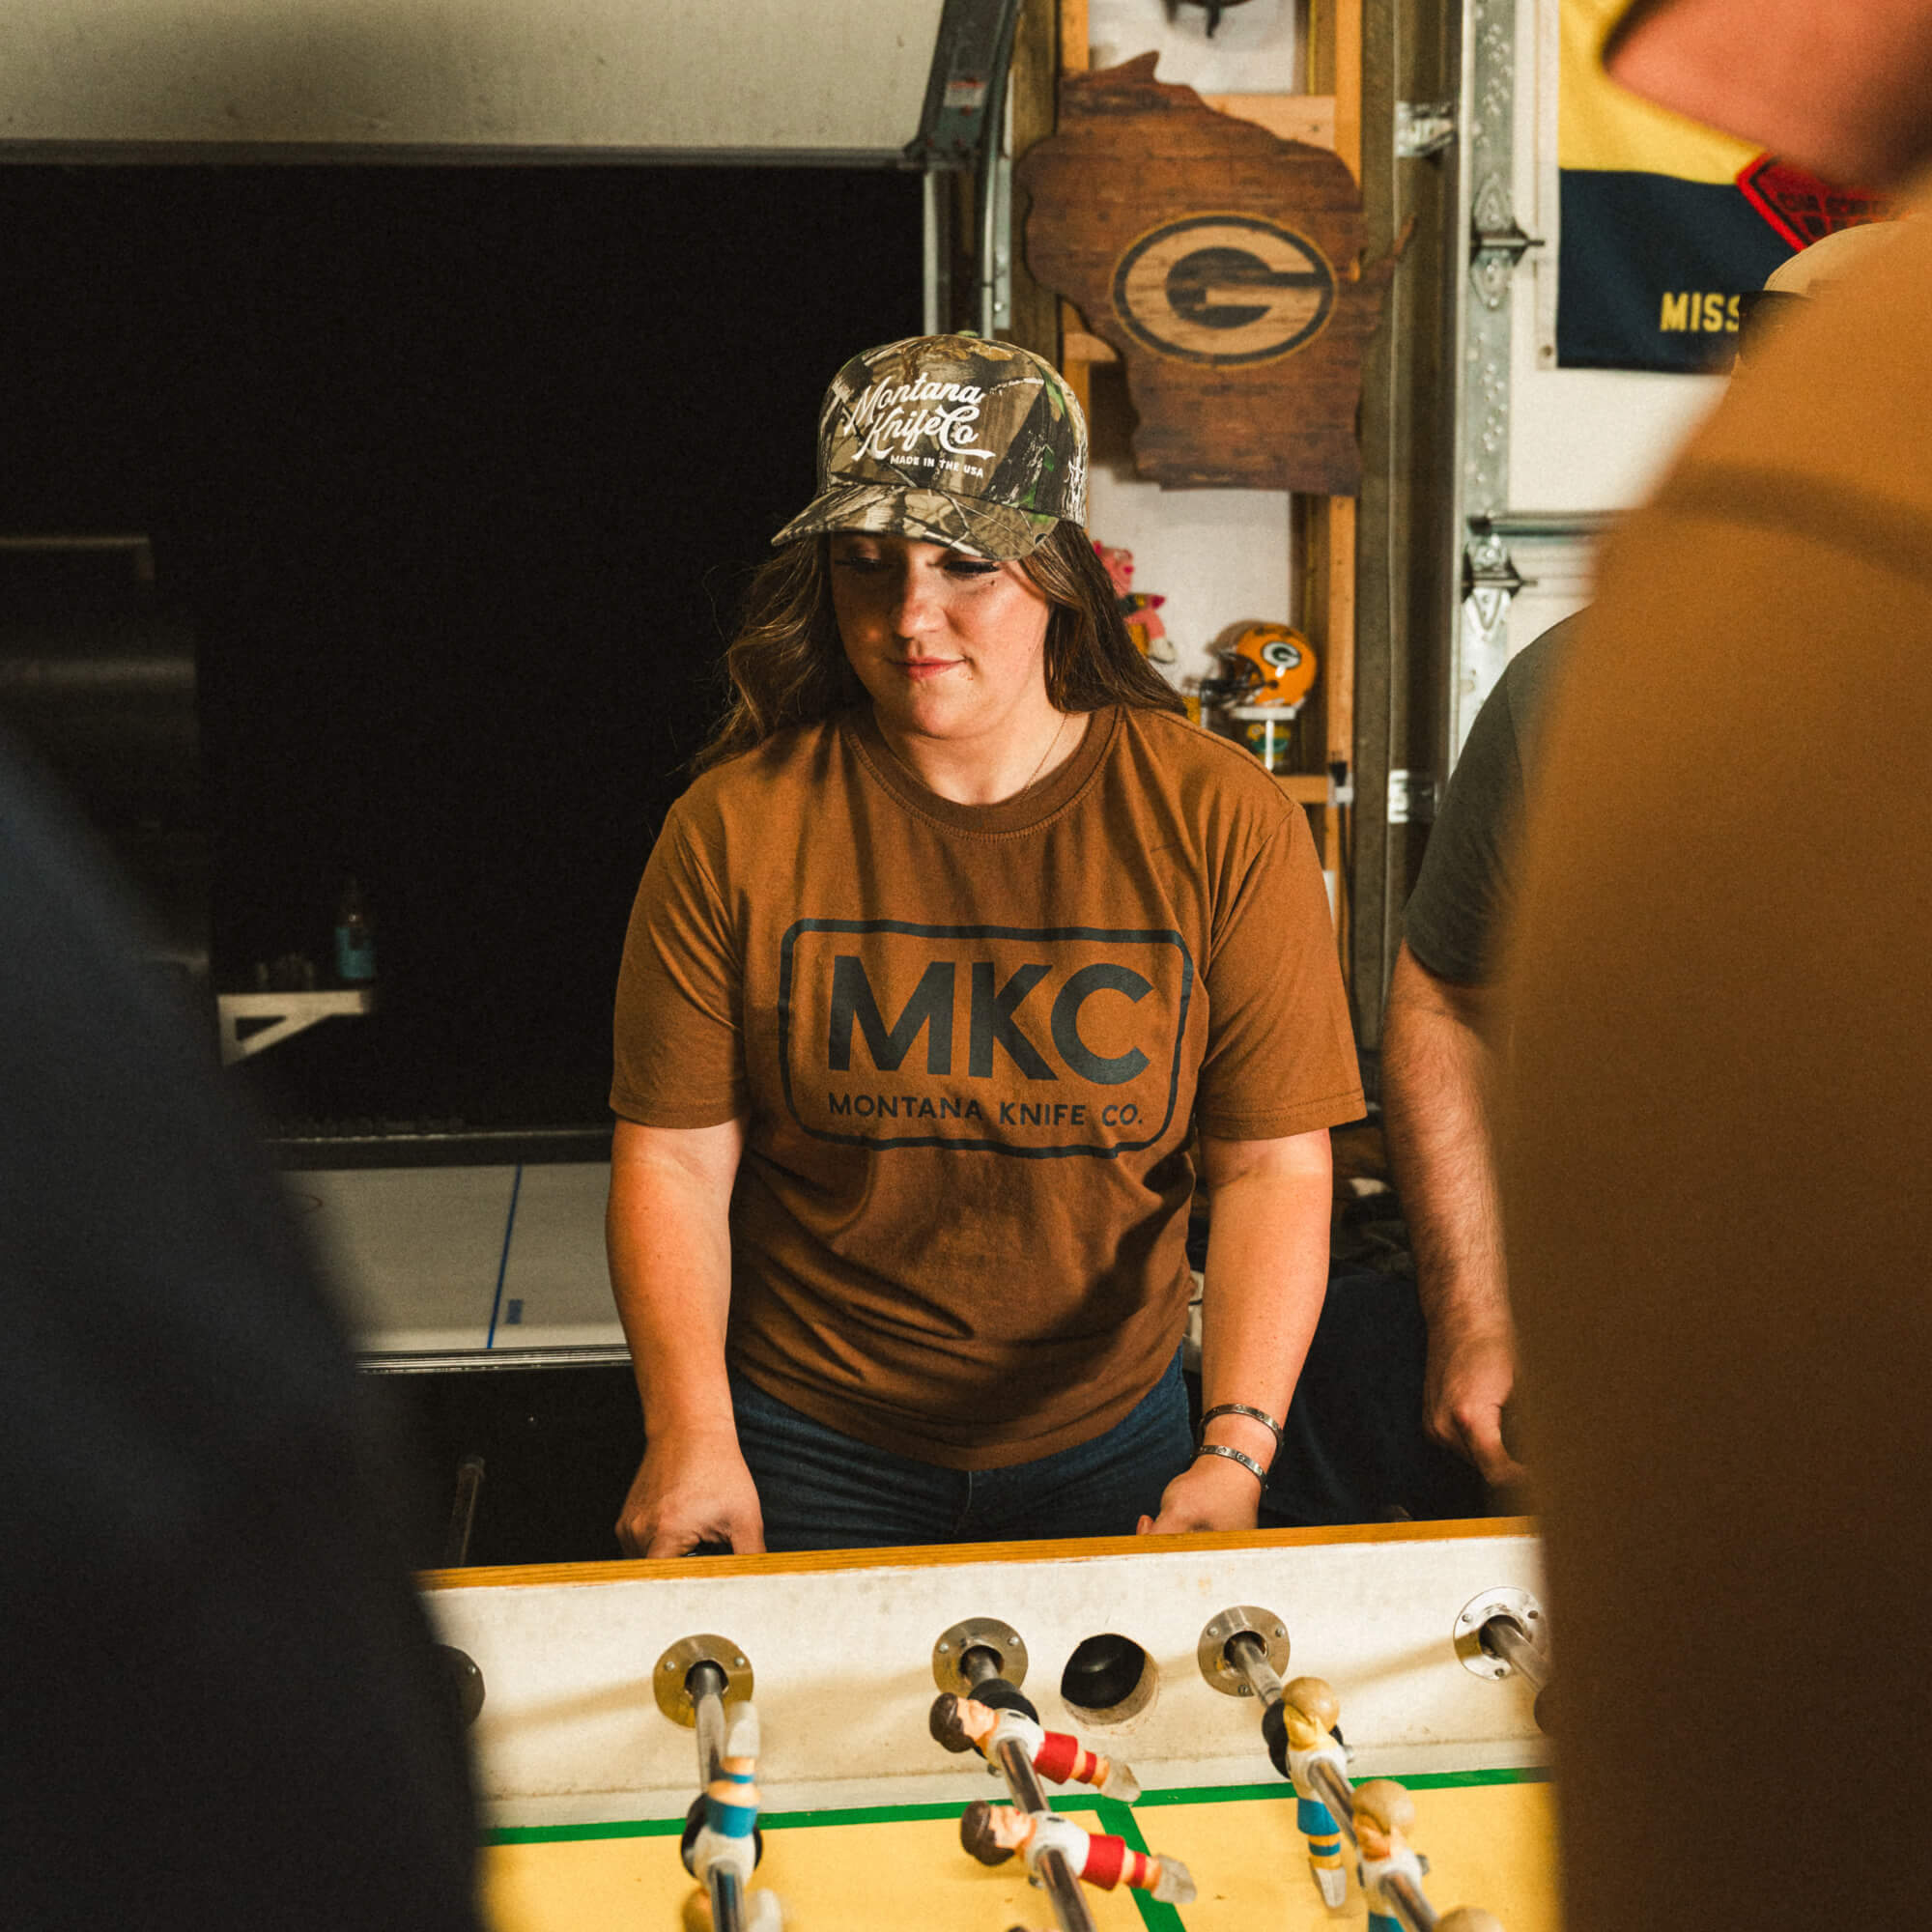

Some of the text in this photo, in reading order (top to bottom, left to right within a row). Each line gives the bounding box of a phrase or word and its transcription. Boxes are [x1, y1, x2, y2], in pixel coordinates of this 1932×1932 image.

[1126, 223, 1322, 356] G
[843, 371, 986, 436] Montana
[890, 455, 983, 479] MADE IN THE USA
[828, 954, 1154, 1085] MKC
[828, 1093, 1143, 1127] MONTANA KNIFE CO.
